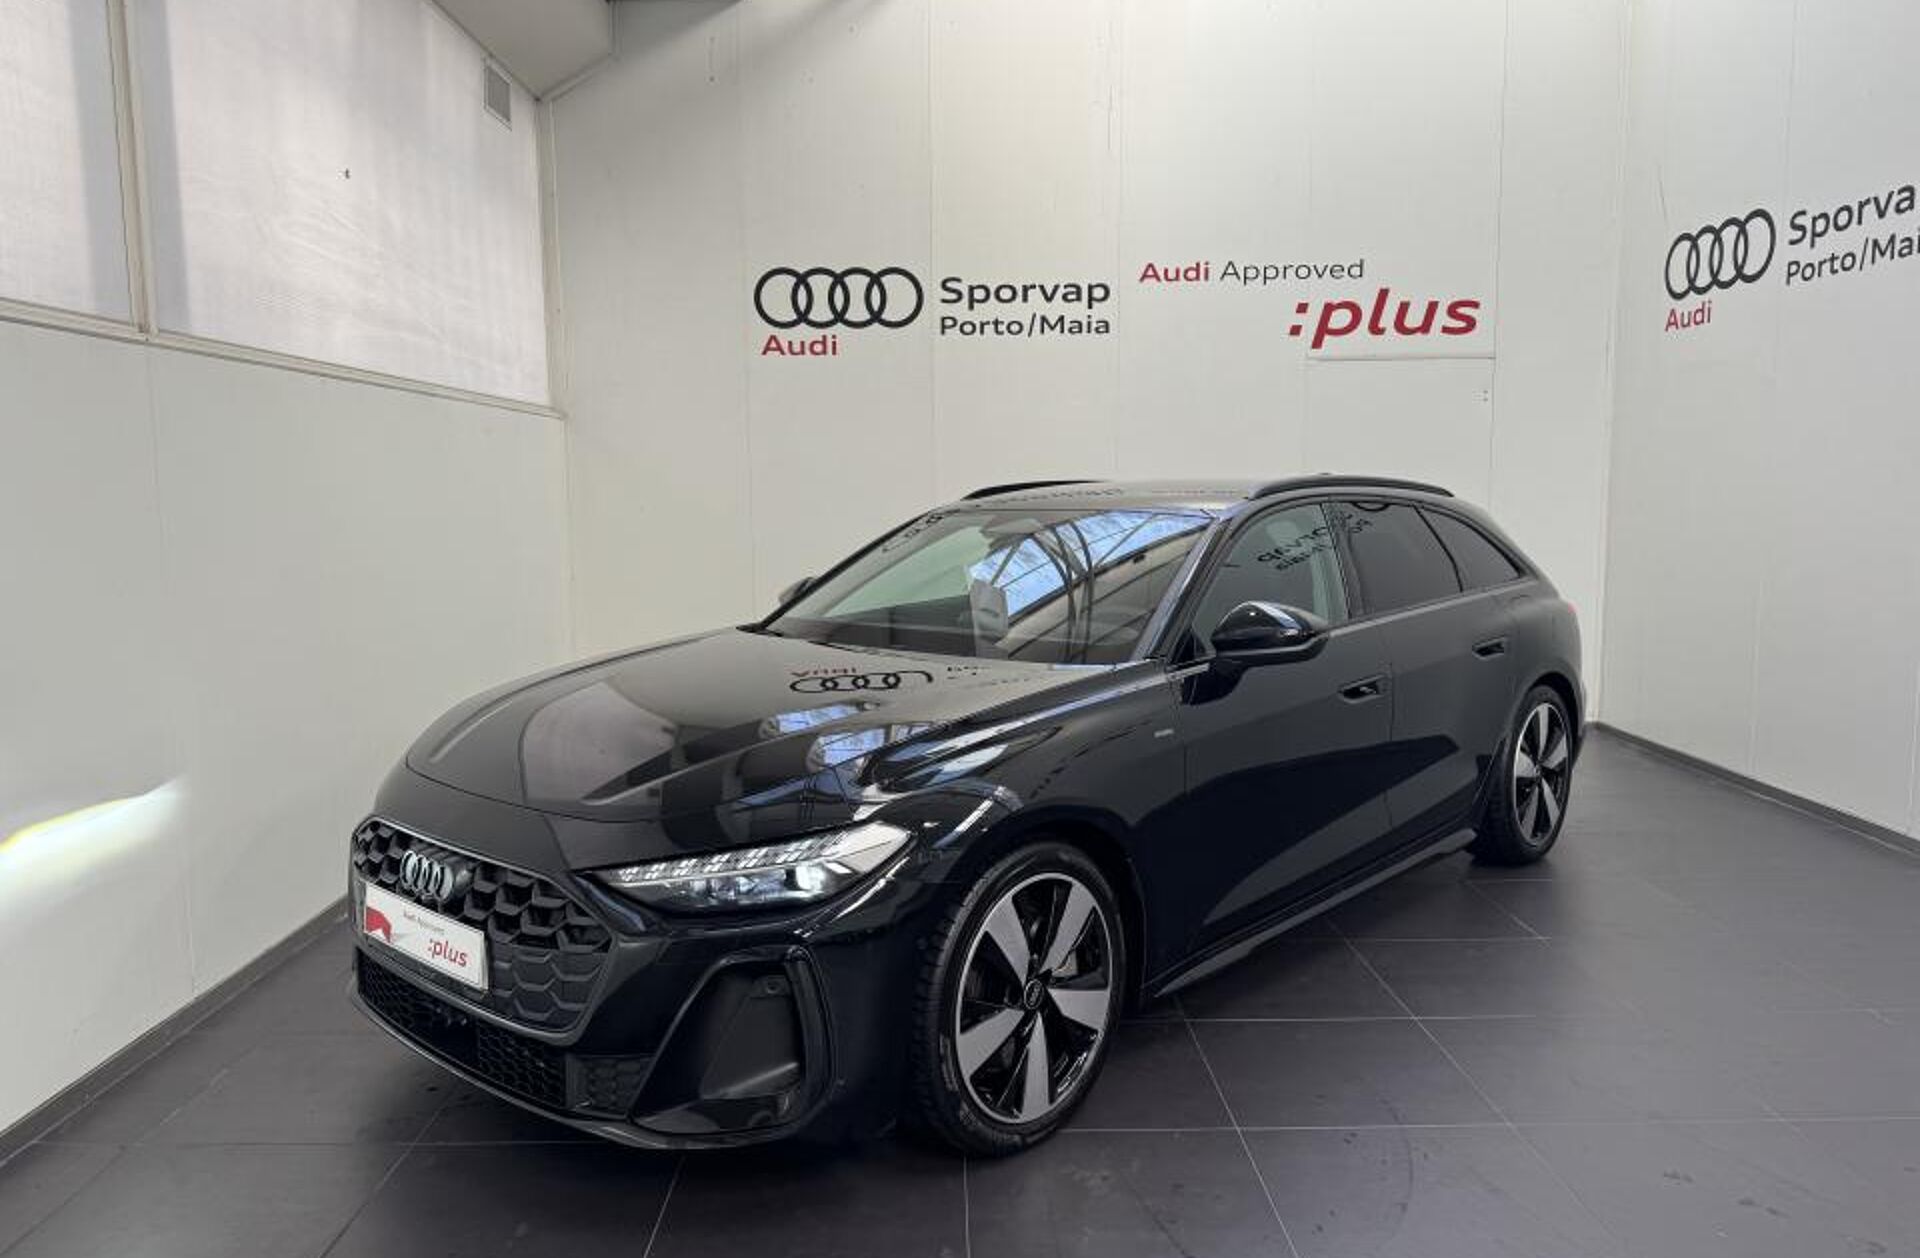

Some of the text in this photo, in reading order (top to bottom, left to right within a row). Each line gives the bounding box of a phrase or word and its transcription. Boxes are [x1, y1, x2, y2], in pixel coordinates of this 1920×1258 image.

[1788, 185, 1916, 249] Sporva
[1139, 259, 1364, 285] Audi Approved
[940, 276, 1111, 309] Sporvap
[939, 313, 1111, 338] Porto/Maia
[1288, 288, 1481, 350] :plus
[1665, 300, 1712, 332] Audi
[761, 335, 838, 356] Audi
